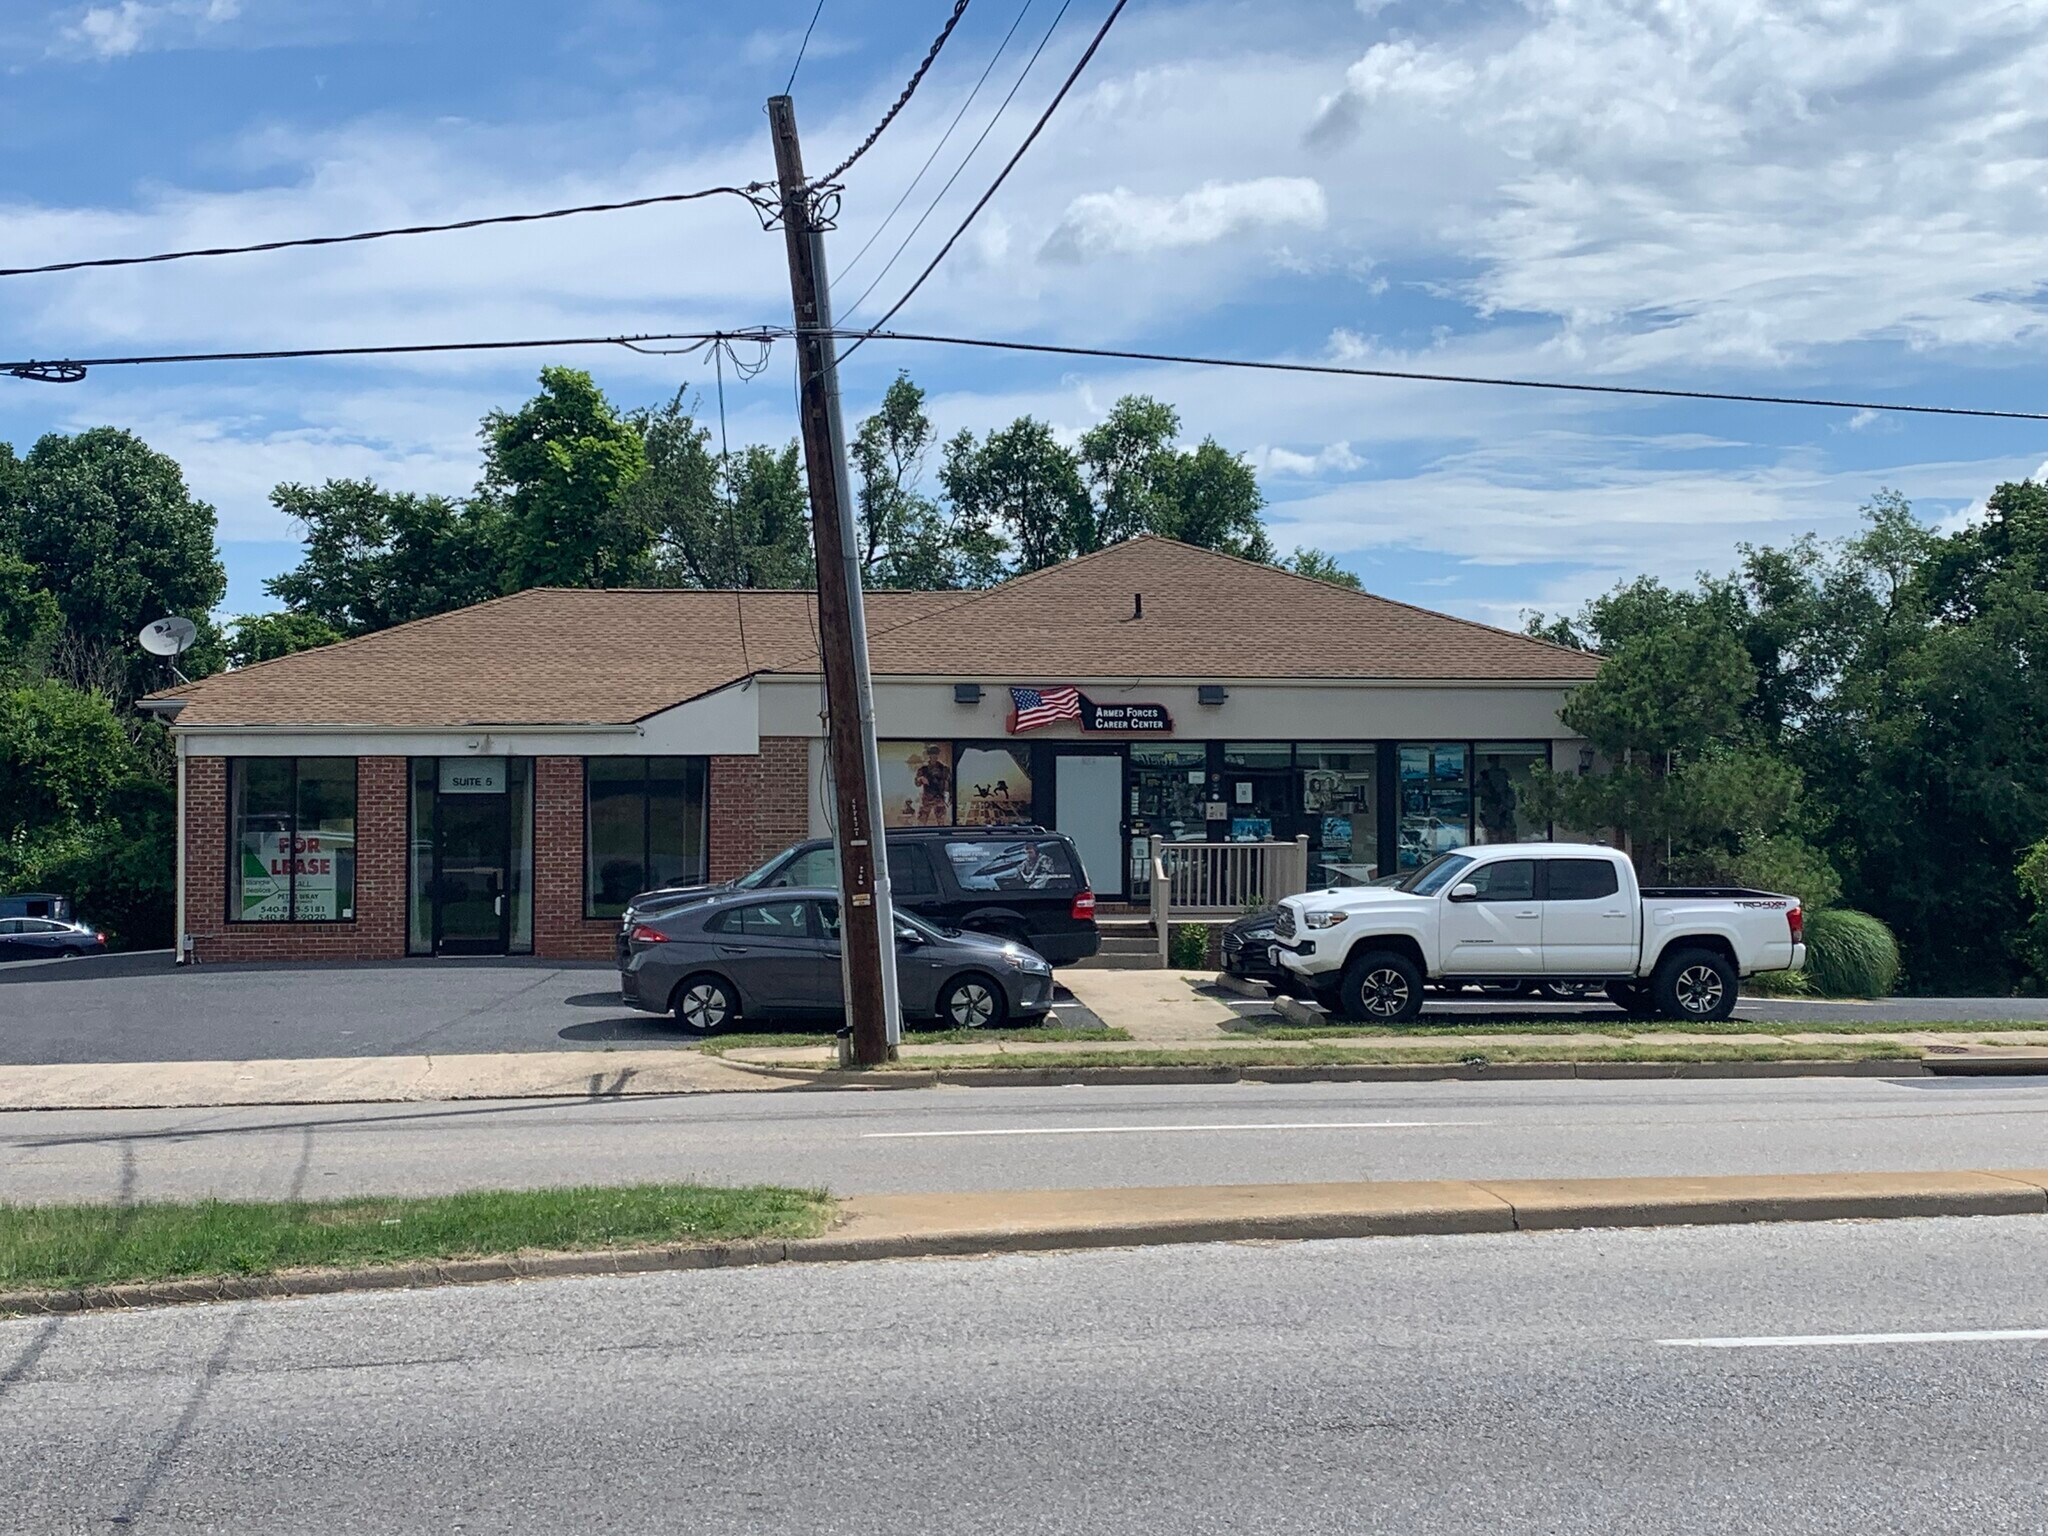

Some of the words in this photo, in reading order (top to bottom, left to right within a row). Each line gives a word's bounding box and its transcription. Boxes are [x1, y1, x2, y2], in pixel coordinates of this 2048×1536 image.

[1095, 707, 1124, 717] ARMED
[1126, 707, 1158, 717] FORCES
[1095, 718, 1128, 728] CAREER
[1131, 718, 1163, 728] CENTER
[452, 777, 482, 786] SUITE
[278, 837, 321, 854] FOR
[271, 859, 331, 875] LEASE
[260, 905, 325, 913] 540-85-5181
